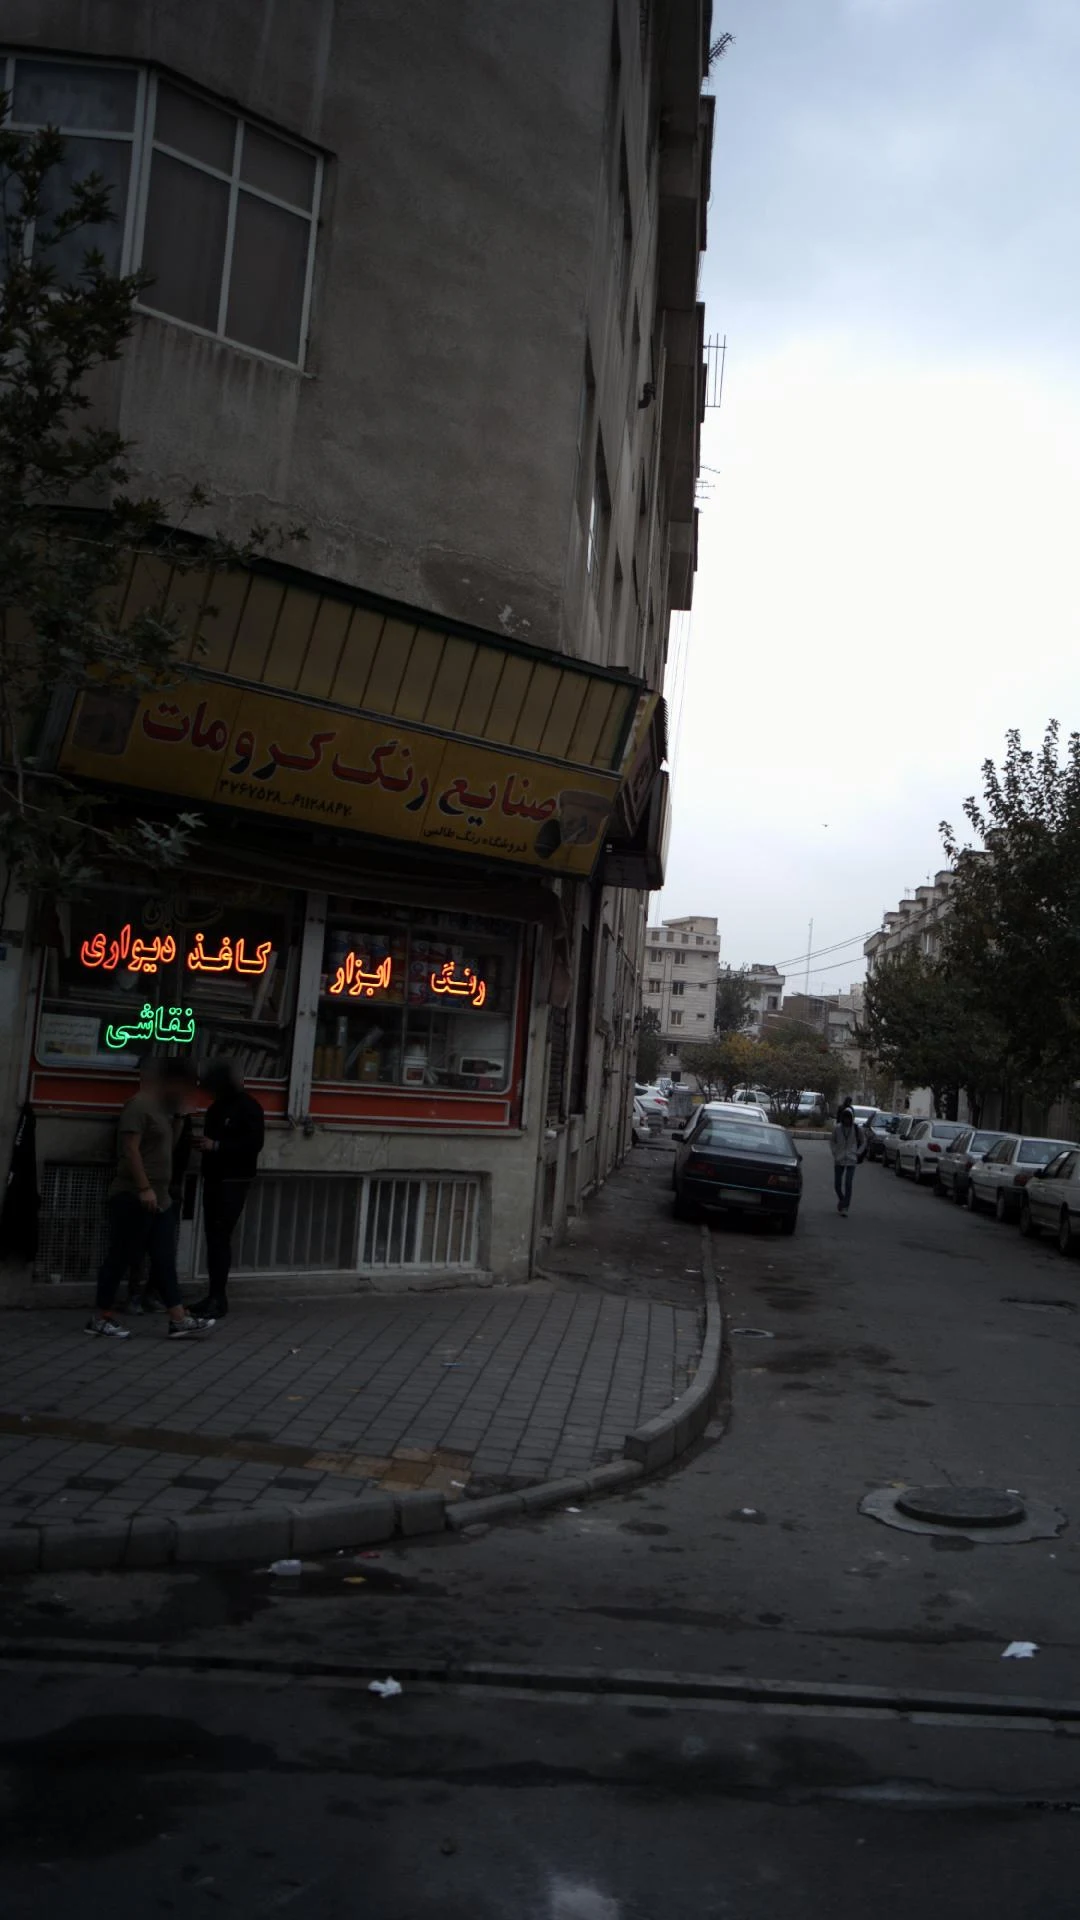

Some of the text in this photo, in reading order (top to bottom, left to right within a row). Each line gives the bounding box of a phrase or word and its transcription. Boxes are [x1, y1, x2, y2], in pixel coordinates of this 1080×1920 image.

[142, 701, 336, 780] کرومات
[331, 740, 428, 811] رنگ
[438, 773, 557, 826] صنایع
[455, 830, 481, 845] رنگ
[80, 923, 271, 975] کاغذ دیواری
[329, 951, 486, 1006] رنگ ابزار
[105, 1003, 196, 1048] نقاشی
